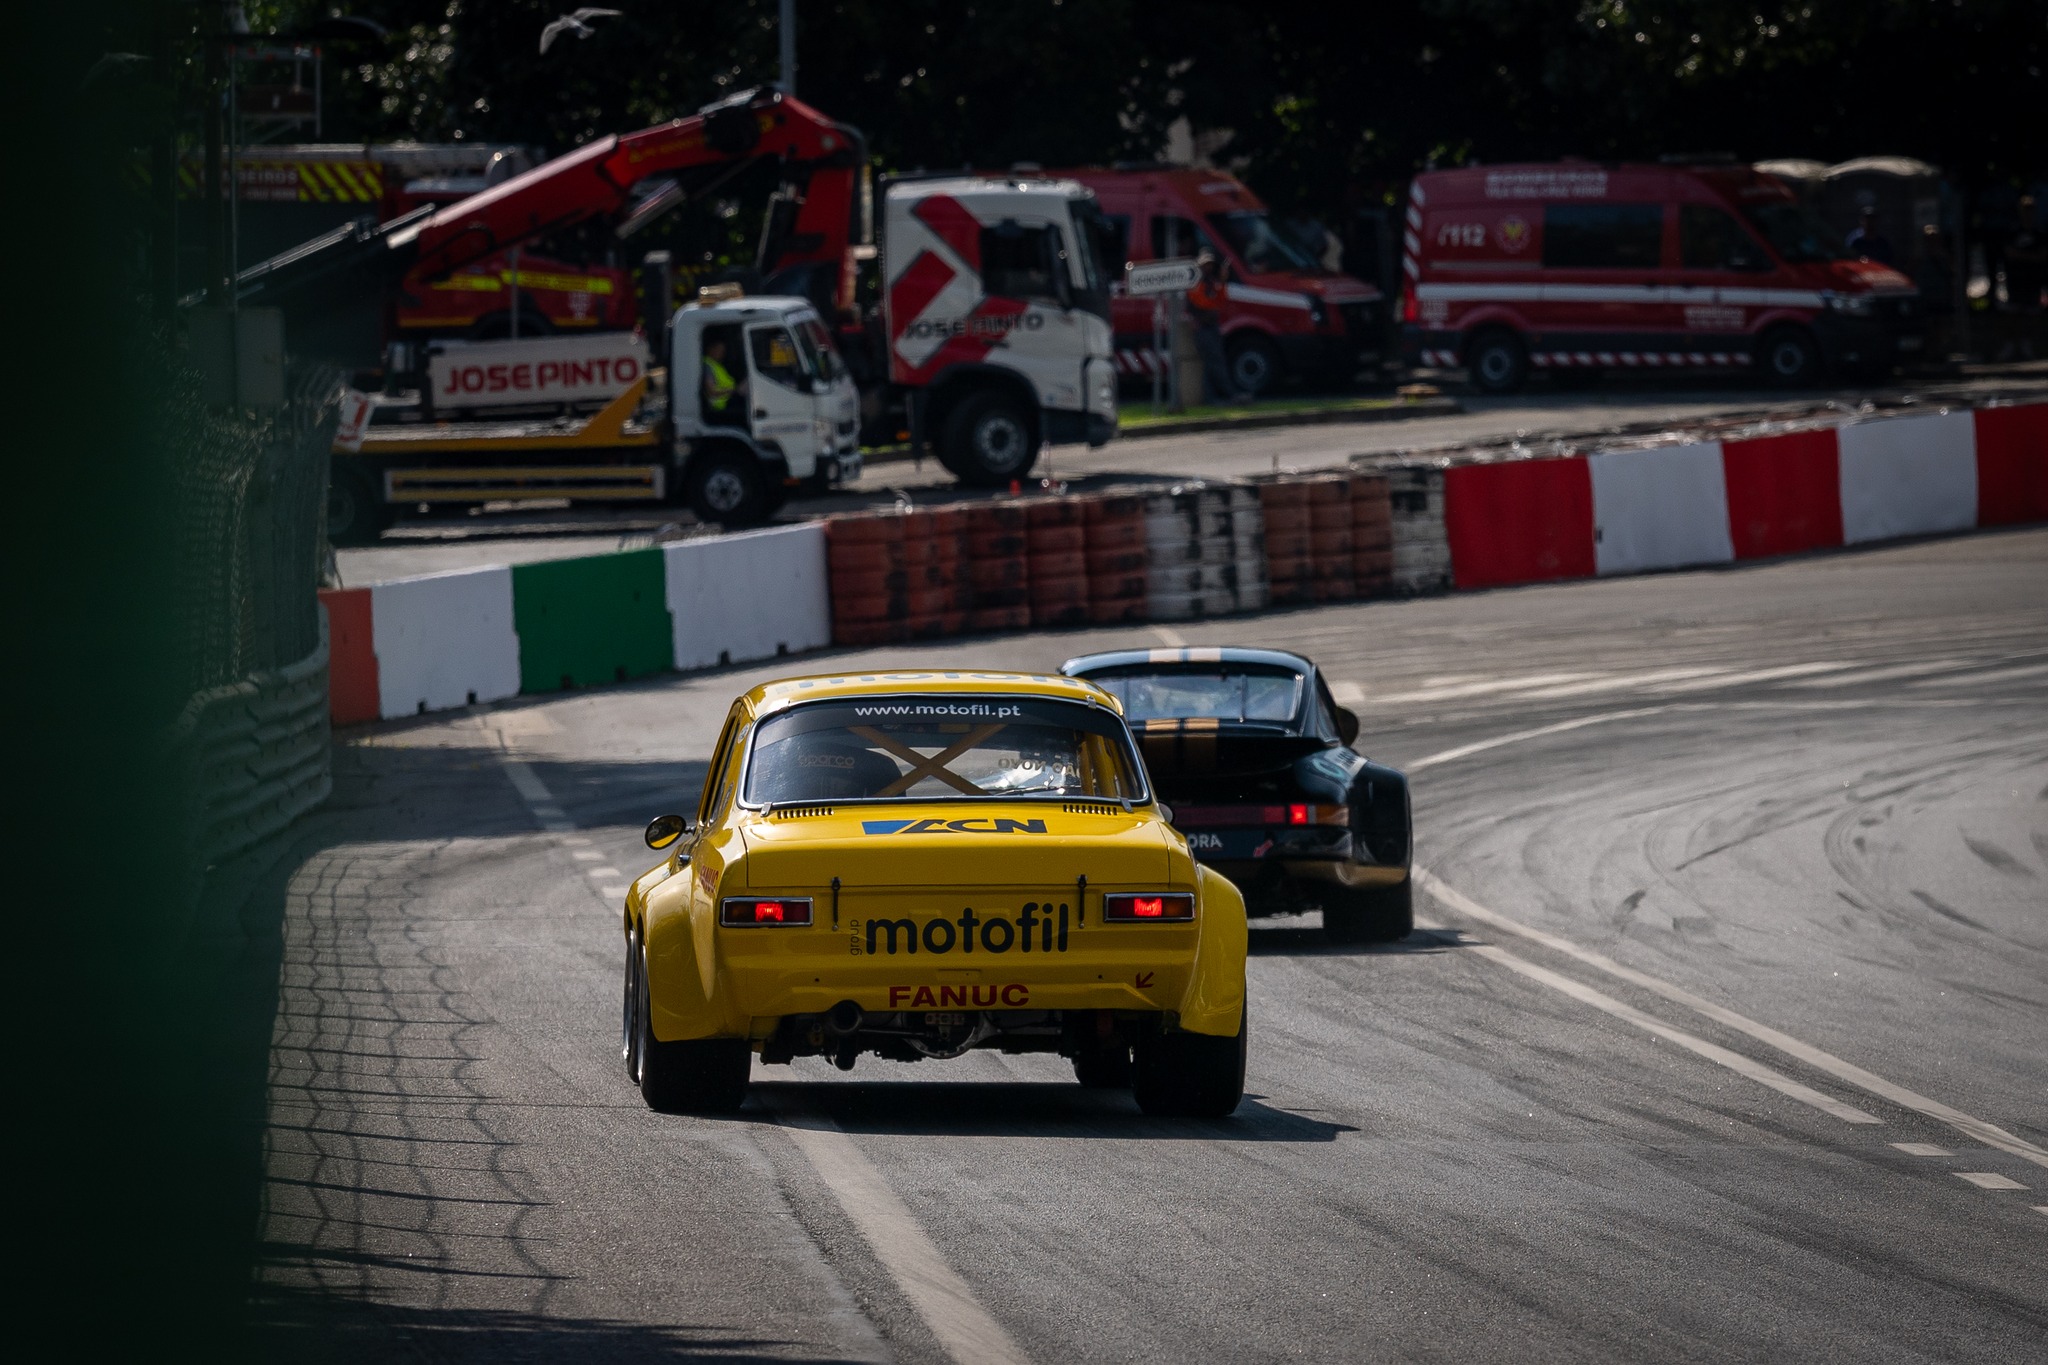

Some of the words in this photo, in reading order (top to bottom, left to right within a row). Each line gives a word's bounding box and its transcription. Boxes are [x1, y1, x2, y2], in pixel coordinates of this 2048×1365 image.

[444, 364, 531, 394] JOSE
[536, 356, 638, 389] PINTO
[855, 702, 1020, 718] www.motofil.pt
[849, 919, 862, 956] group
[866, 902, 1068, 954] motofil
[889, 984, 1030, 1007] FANUC
